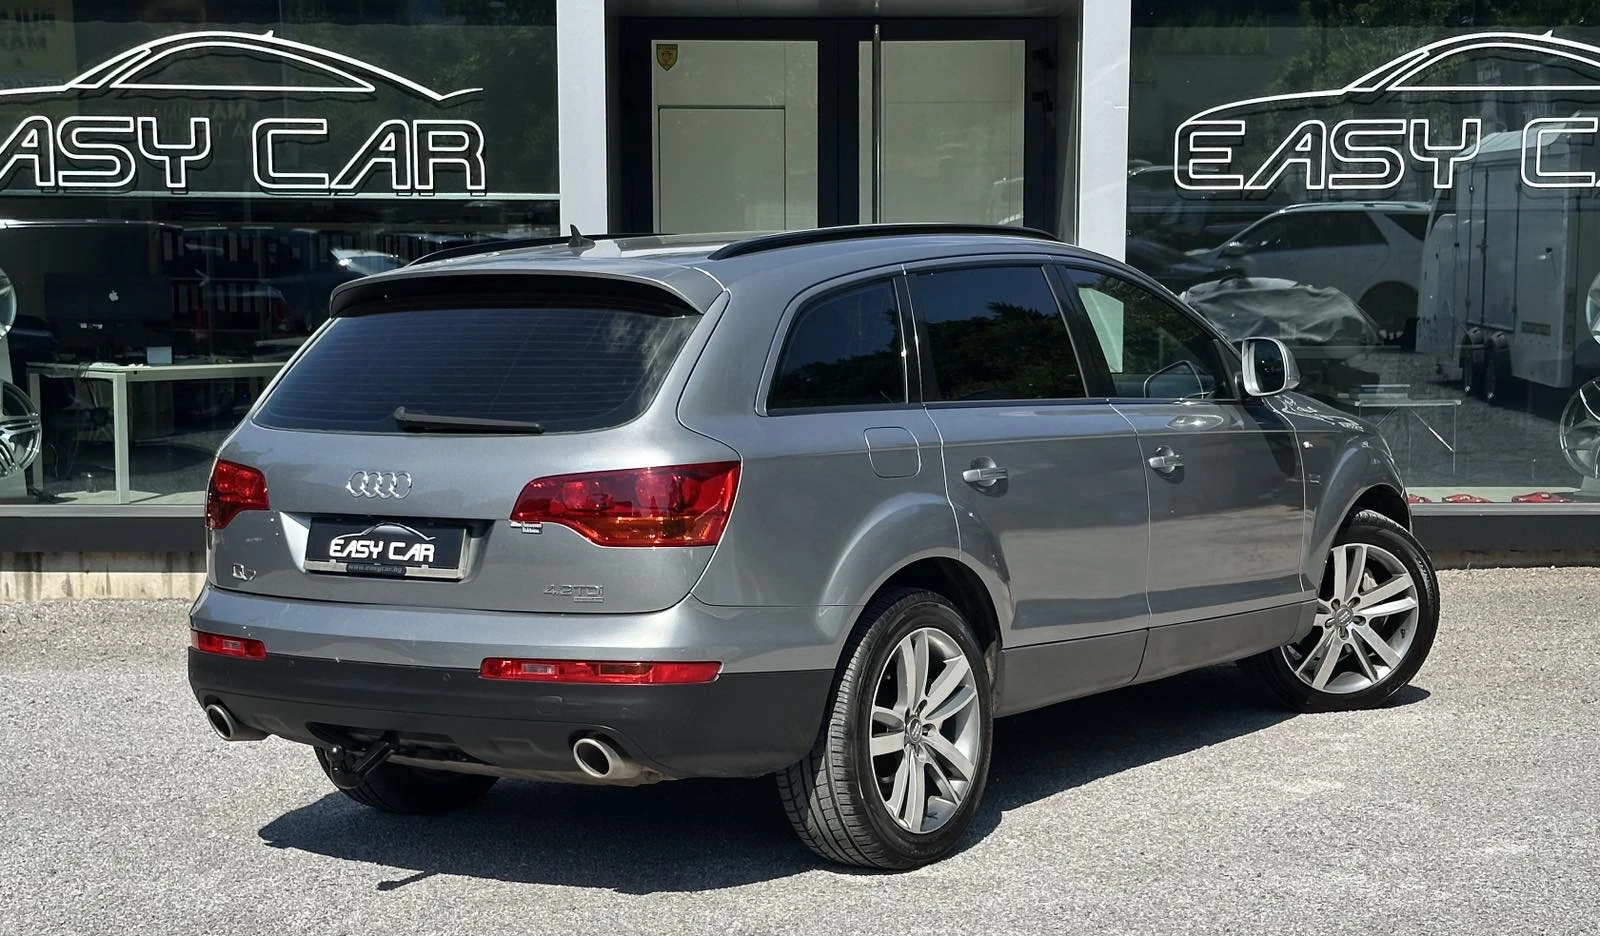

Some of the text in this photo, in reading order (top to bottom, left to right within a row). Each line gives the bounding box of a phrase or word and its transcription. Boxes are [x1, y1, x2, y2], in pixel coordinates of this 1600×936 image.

[252, 118, 487, 190] CAR
[1173, 116, 1600, 190] EASY C
[329, 538, 435, 563] EASY CAR
